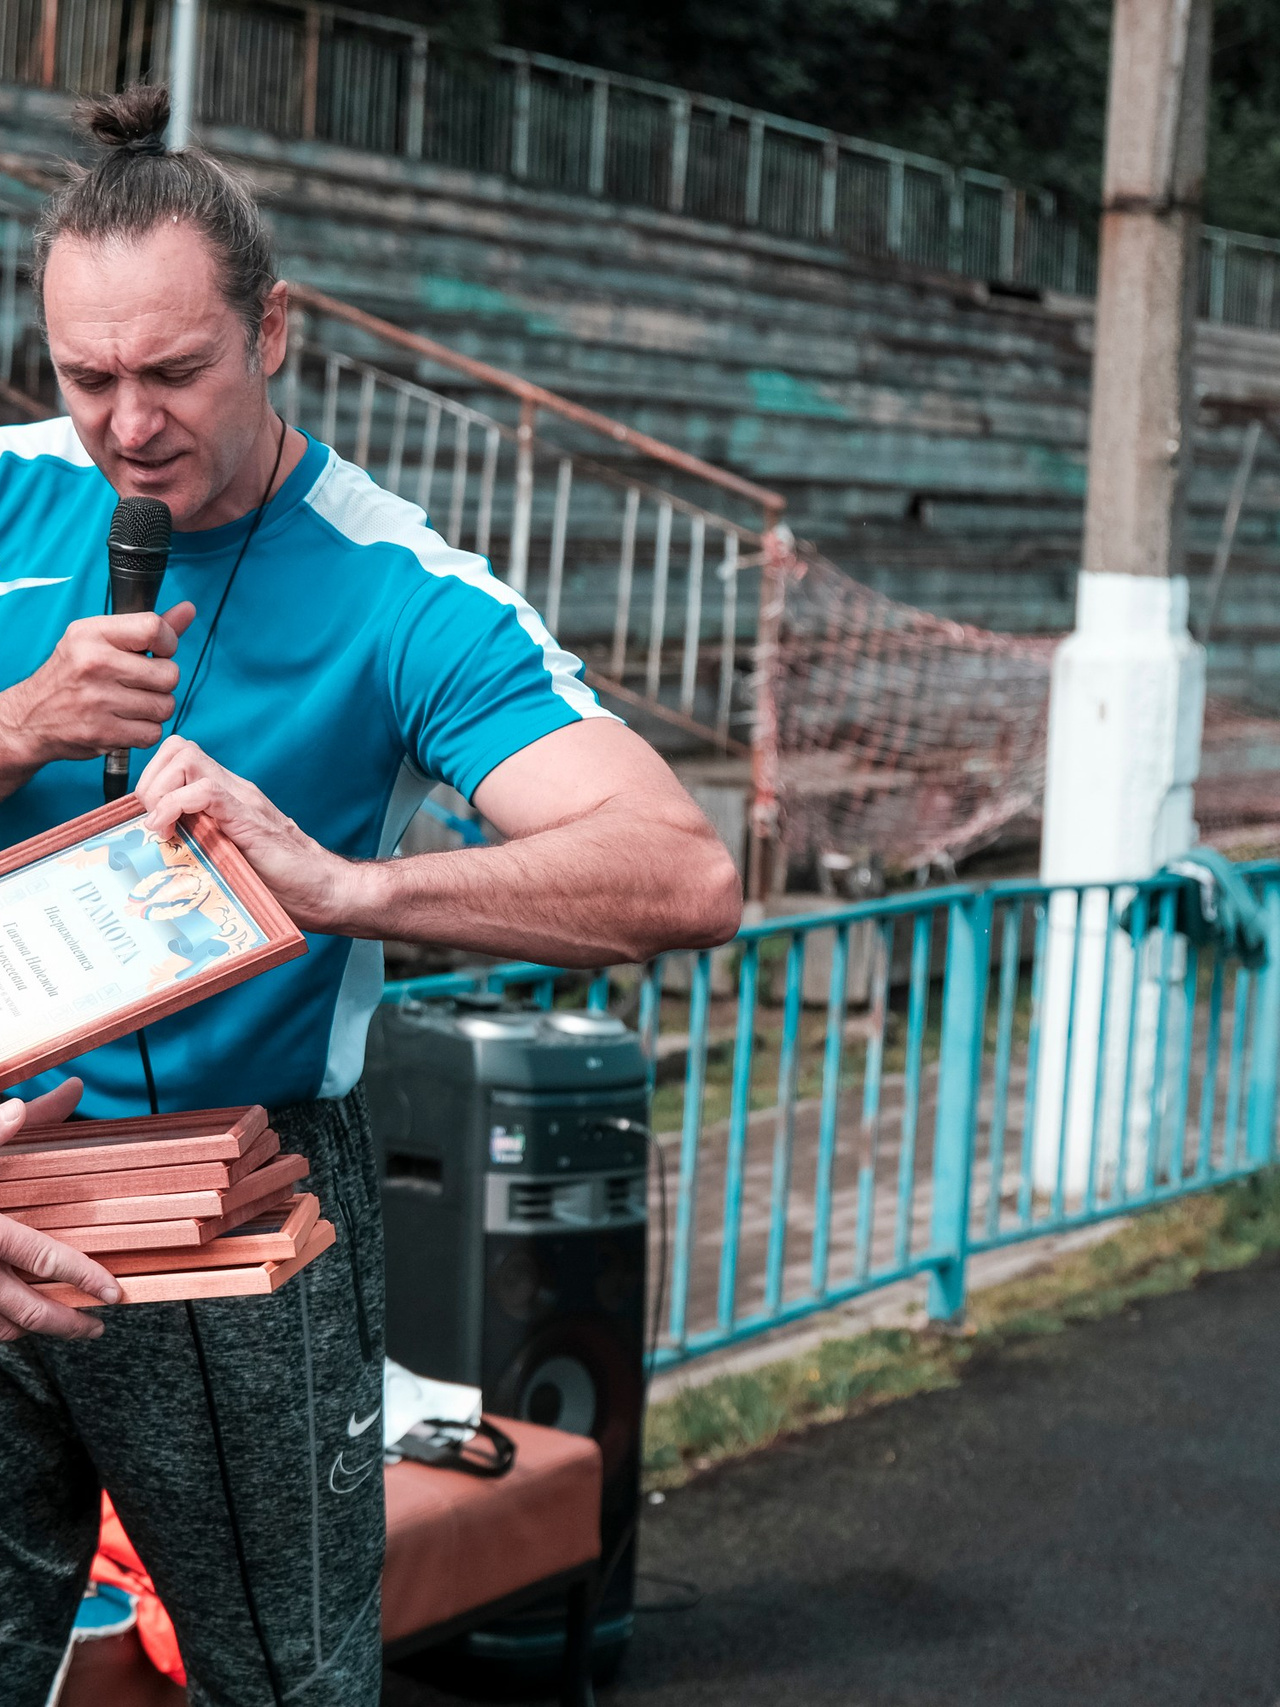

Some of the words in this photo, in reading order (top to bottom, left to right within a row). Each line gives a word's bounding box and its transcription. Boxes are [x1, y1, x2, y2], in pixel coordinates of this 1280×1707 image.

[2, 921, 31, 957] Гаязова
[25, 956, 59, 998] Надежда
[43, 905, 94, 972] Награждается
[71, 880, 141, 965] ГРАМОТА
